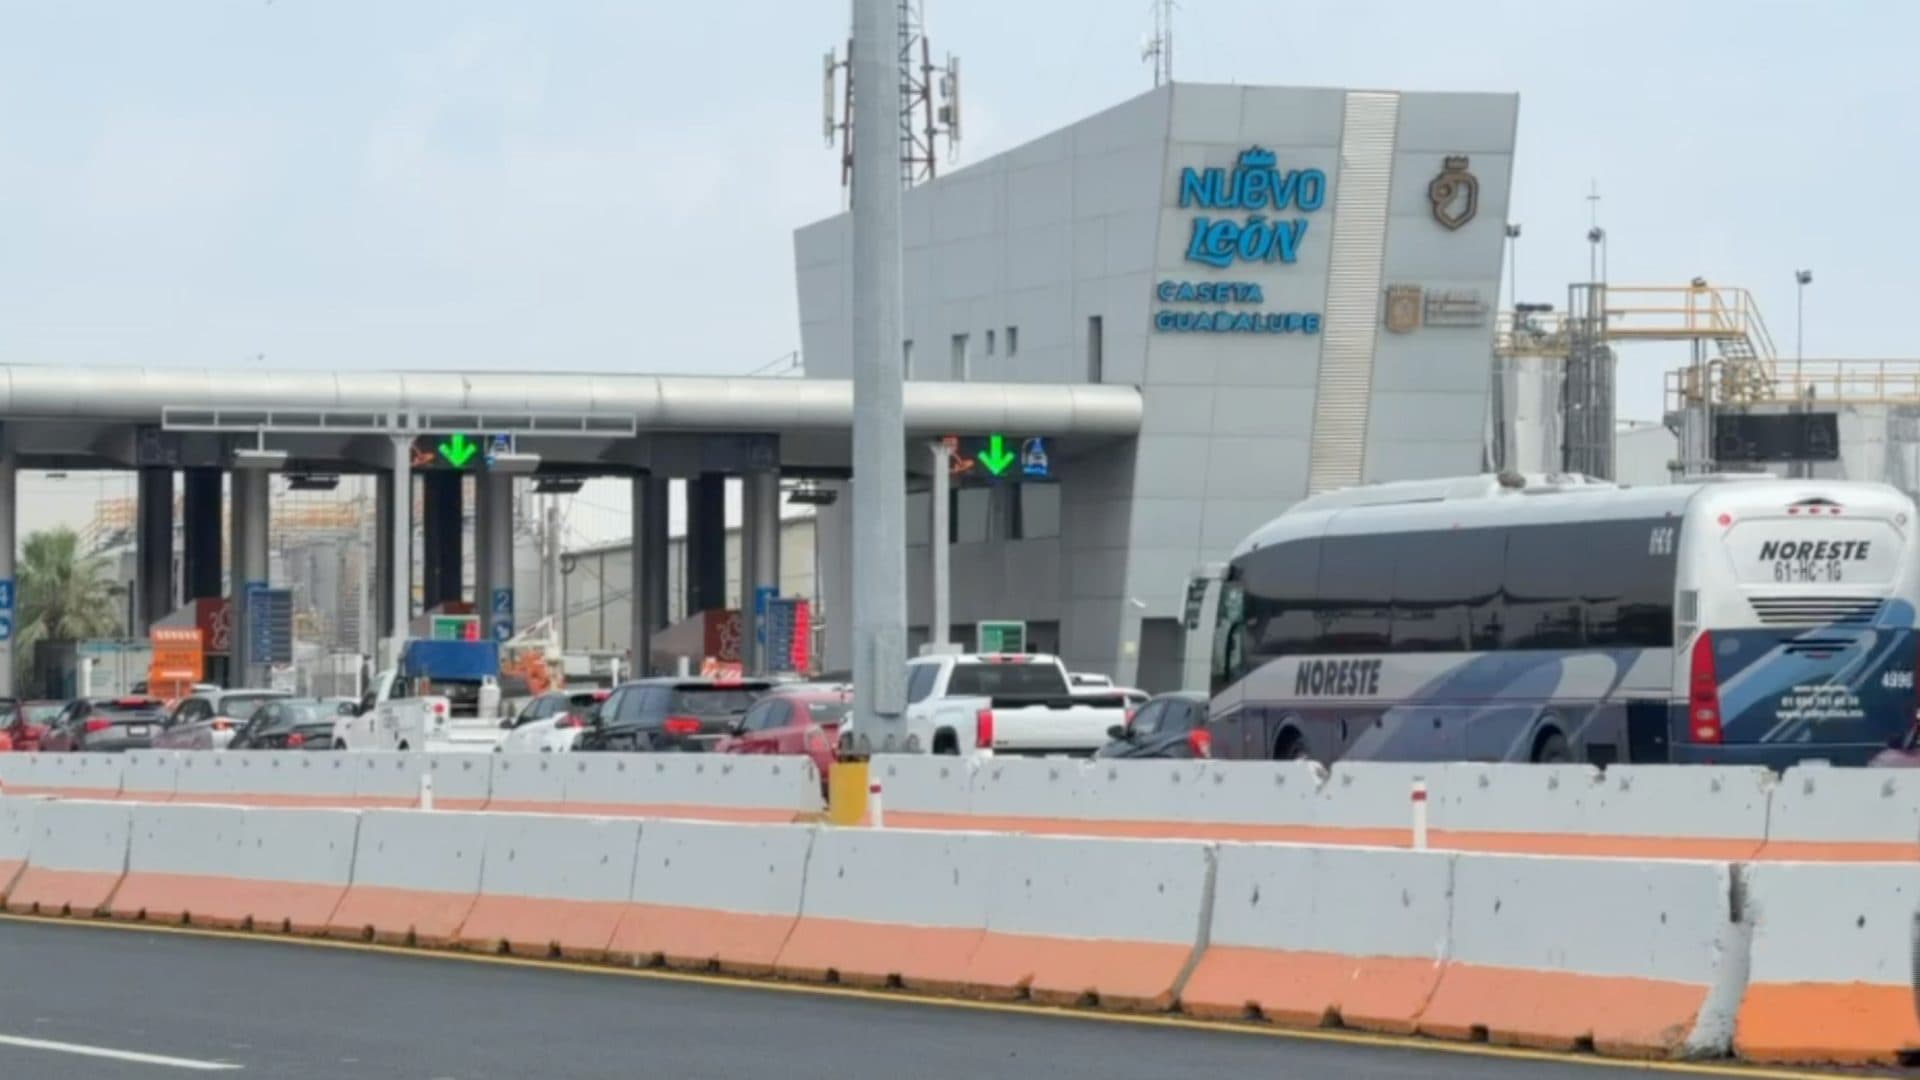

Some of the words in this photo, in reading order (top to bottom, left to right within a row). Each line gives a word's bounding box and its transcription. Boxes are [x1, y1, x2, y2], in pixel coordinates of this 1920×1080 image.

[1157, 281, 1264, 304] CASETA
[1154, 310, 1321, 335] GUADALUPE
[1759, 540, 1870, 560] NORESTE
[1294, 659, 1382, 696] NORESTE
